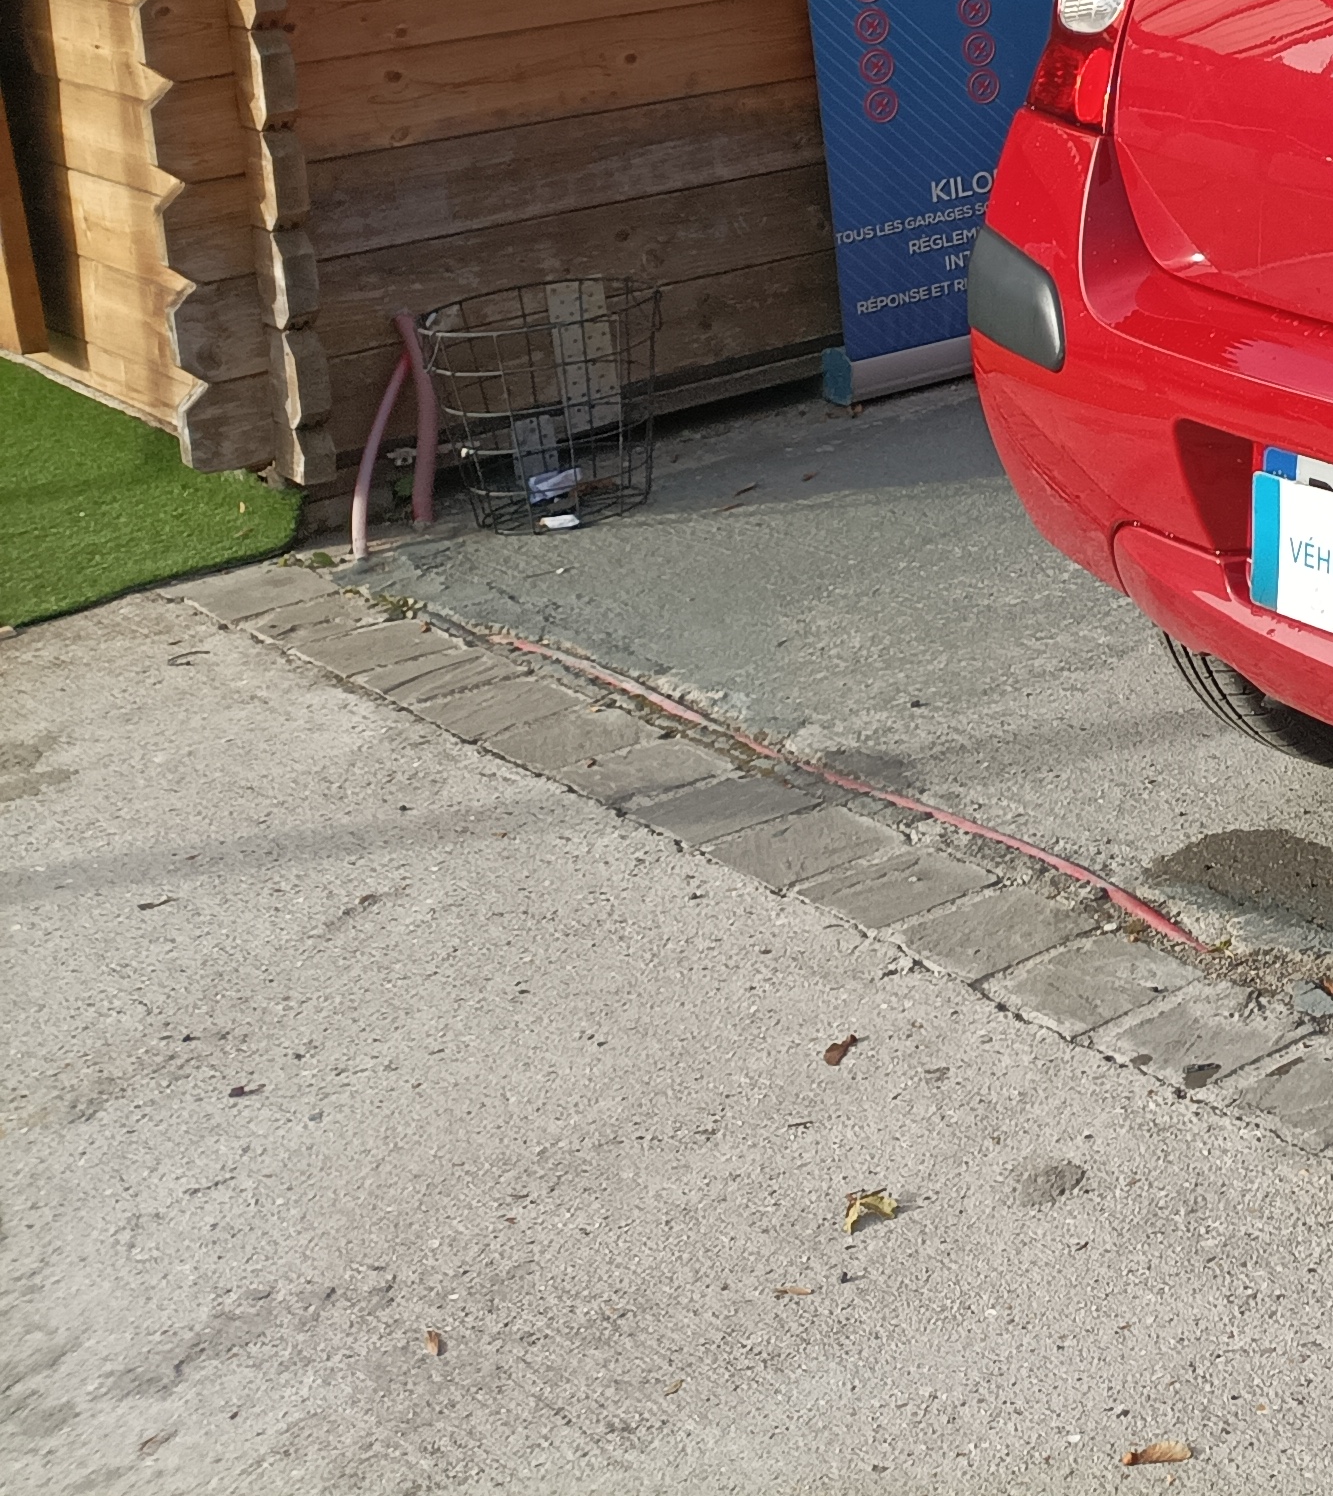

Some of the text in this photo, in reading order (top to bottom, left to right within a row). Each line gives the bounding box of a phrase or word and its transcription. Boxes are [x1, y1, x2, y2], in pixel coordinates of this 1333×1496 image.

[836, 225, 874, 245] TOUS
[876, 219, 903, 237] LES
[905, 208, 973, 230] GARAGES
[857, 286, 929, 316] RÉPONSE
[931, 281, 951, 298] ET
